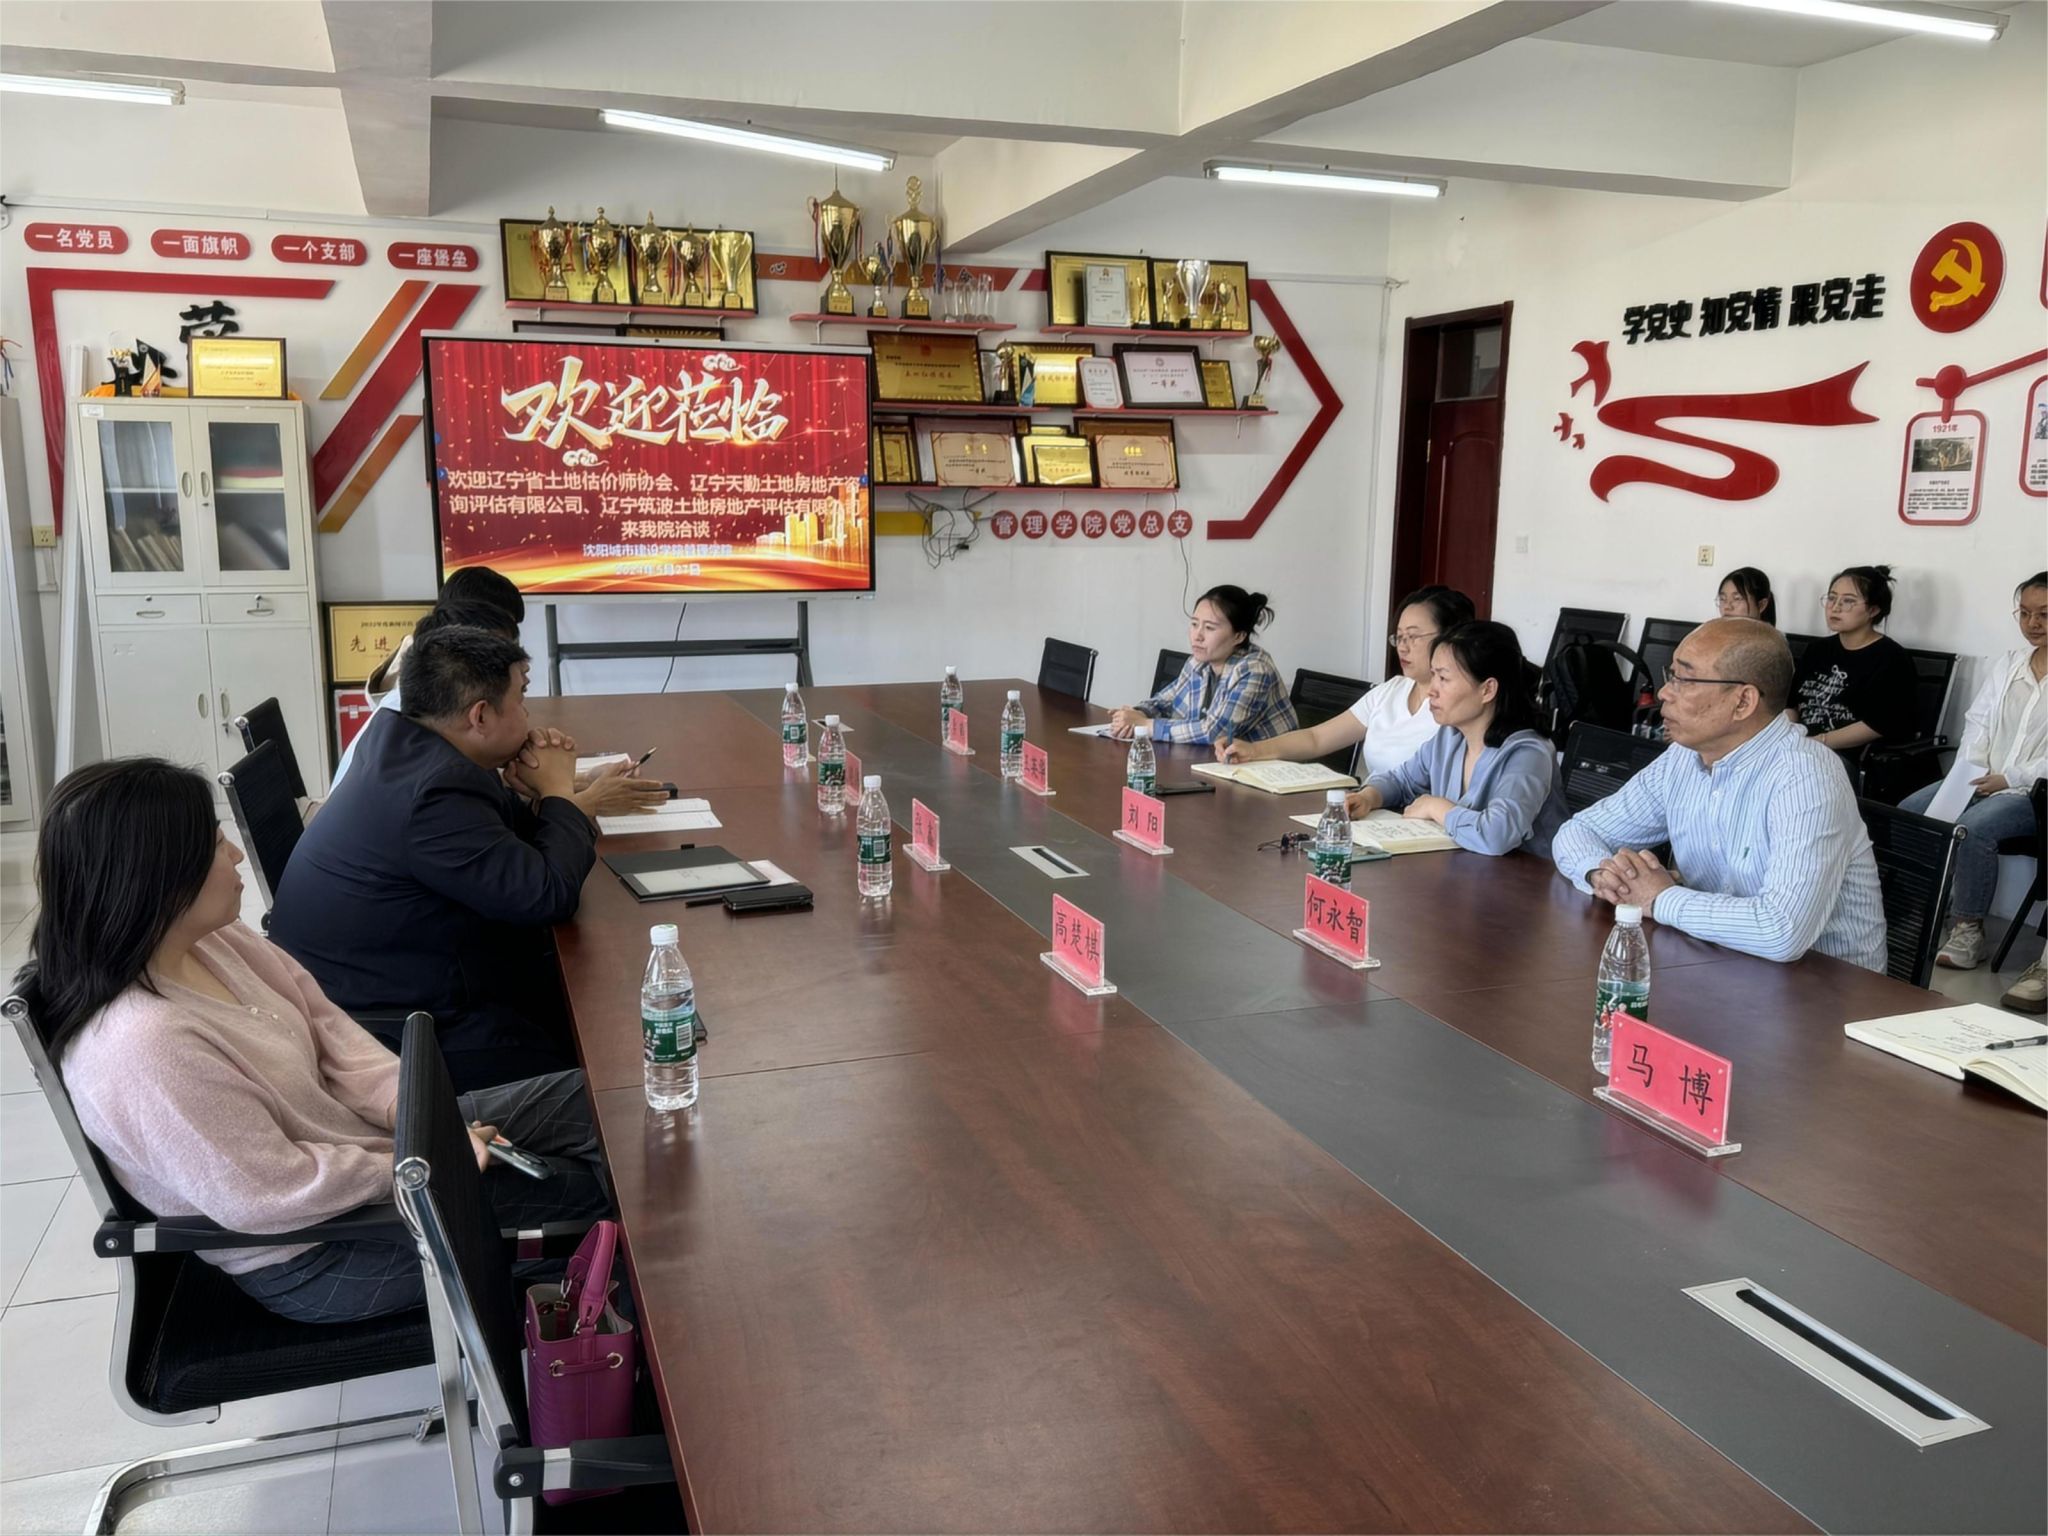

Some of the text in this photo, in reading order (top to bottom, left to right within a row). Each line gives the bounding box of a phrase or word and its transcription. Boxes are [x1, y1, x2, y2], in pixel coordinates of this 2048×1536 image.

[35, 228, 115, 249] 一名党员
[162, 235, 239, 255] 一面旗帜
[283, 240, 356, 262] 一个支部
[398, 248, 468, 268] 一座堡垒
[1622, 273, 1887, 345] 学党史 知党情 跟党走
[501, 355, 789, 450] 欢迎莅临
[1932, 424, 1959, 433] 1921年
[621, 520, 711, 539] 来我院洽谈
[996, 515, 1188, 535] 管理学院党总支
[1127, 803, 1158, 833] 刘阳
[1307, 888, 1363, 944] 何永智
[1055, 908, 1100, 964] 高楚棋
[1627, 1043, 1713, 1116] 马博
